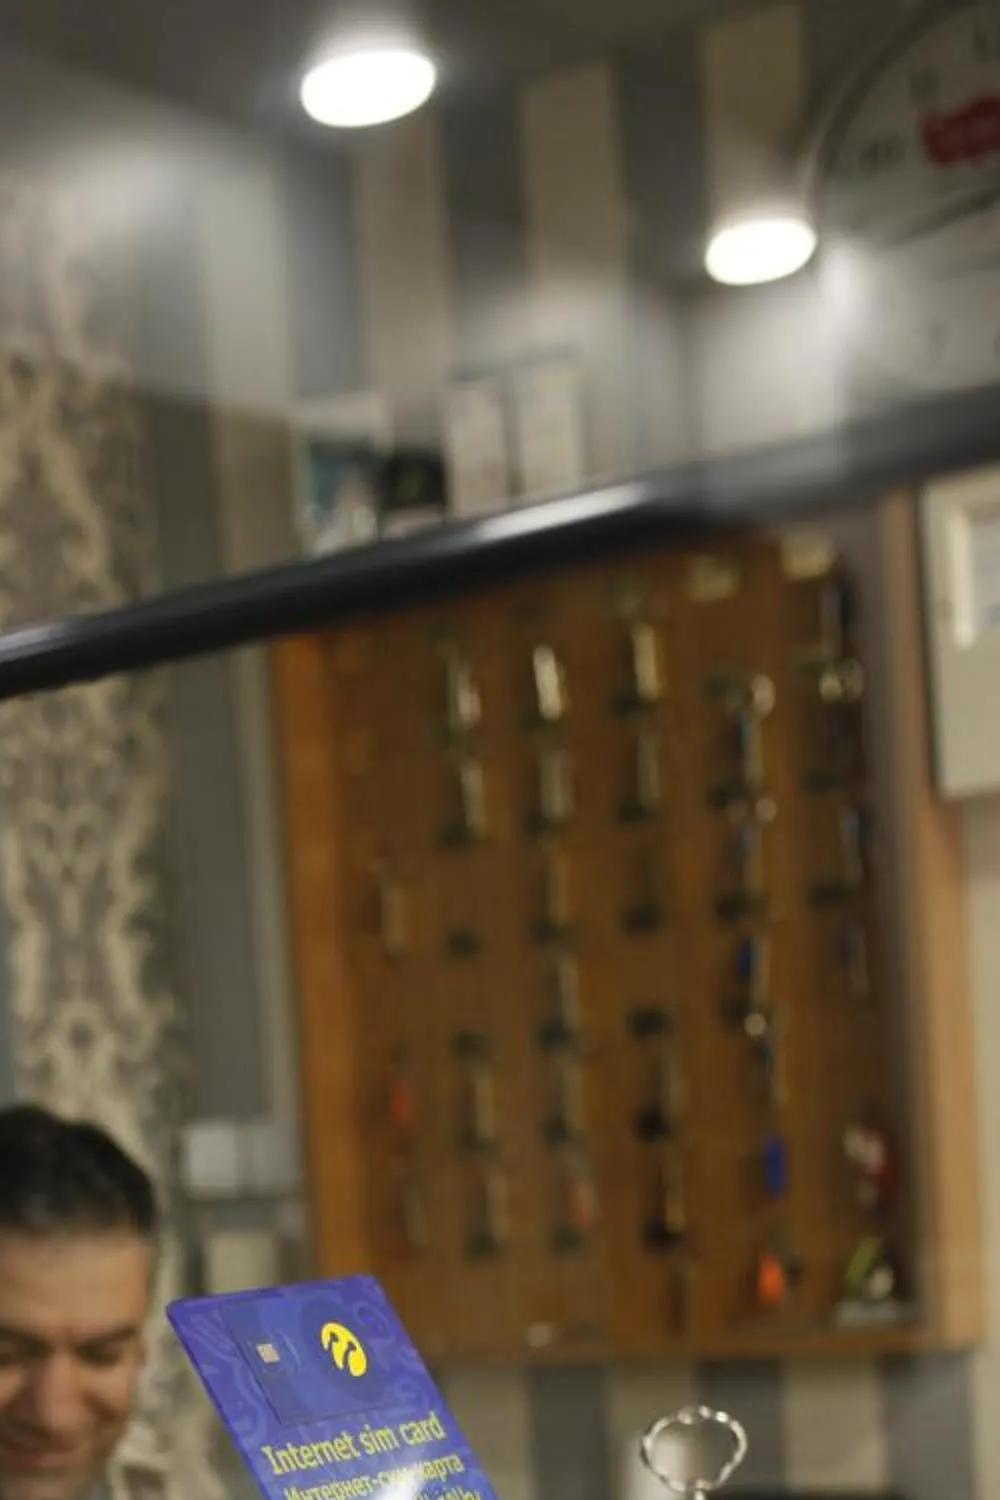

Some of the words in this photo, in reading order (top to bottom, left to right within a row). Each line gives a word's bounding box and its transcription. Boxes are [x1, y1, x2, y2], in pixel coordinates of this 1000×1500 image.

[262, 1431, 361, 1475] Internet
[359, 1424, 400, 1456] sim
[400, 1410, 447, 1446] card
